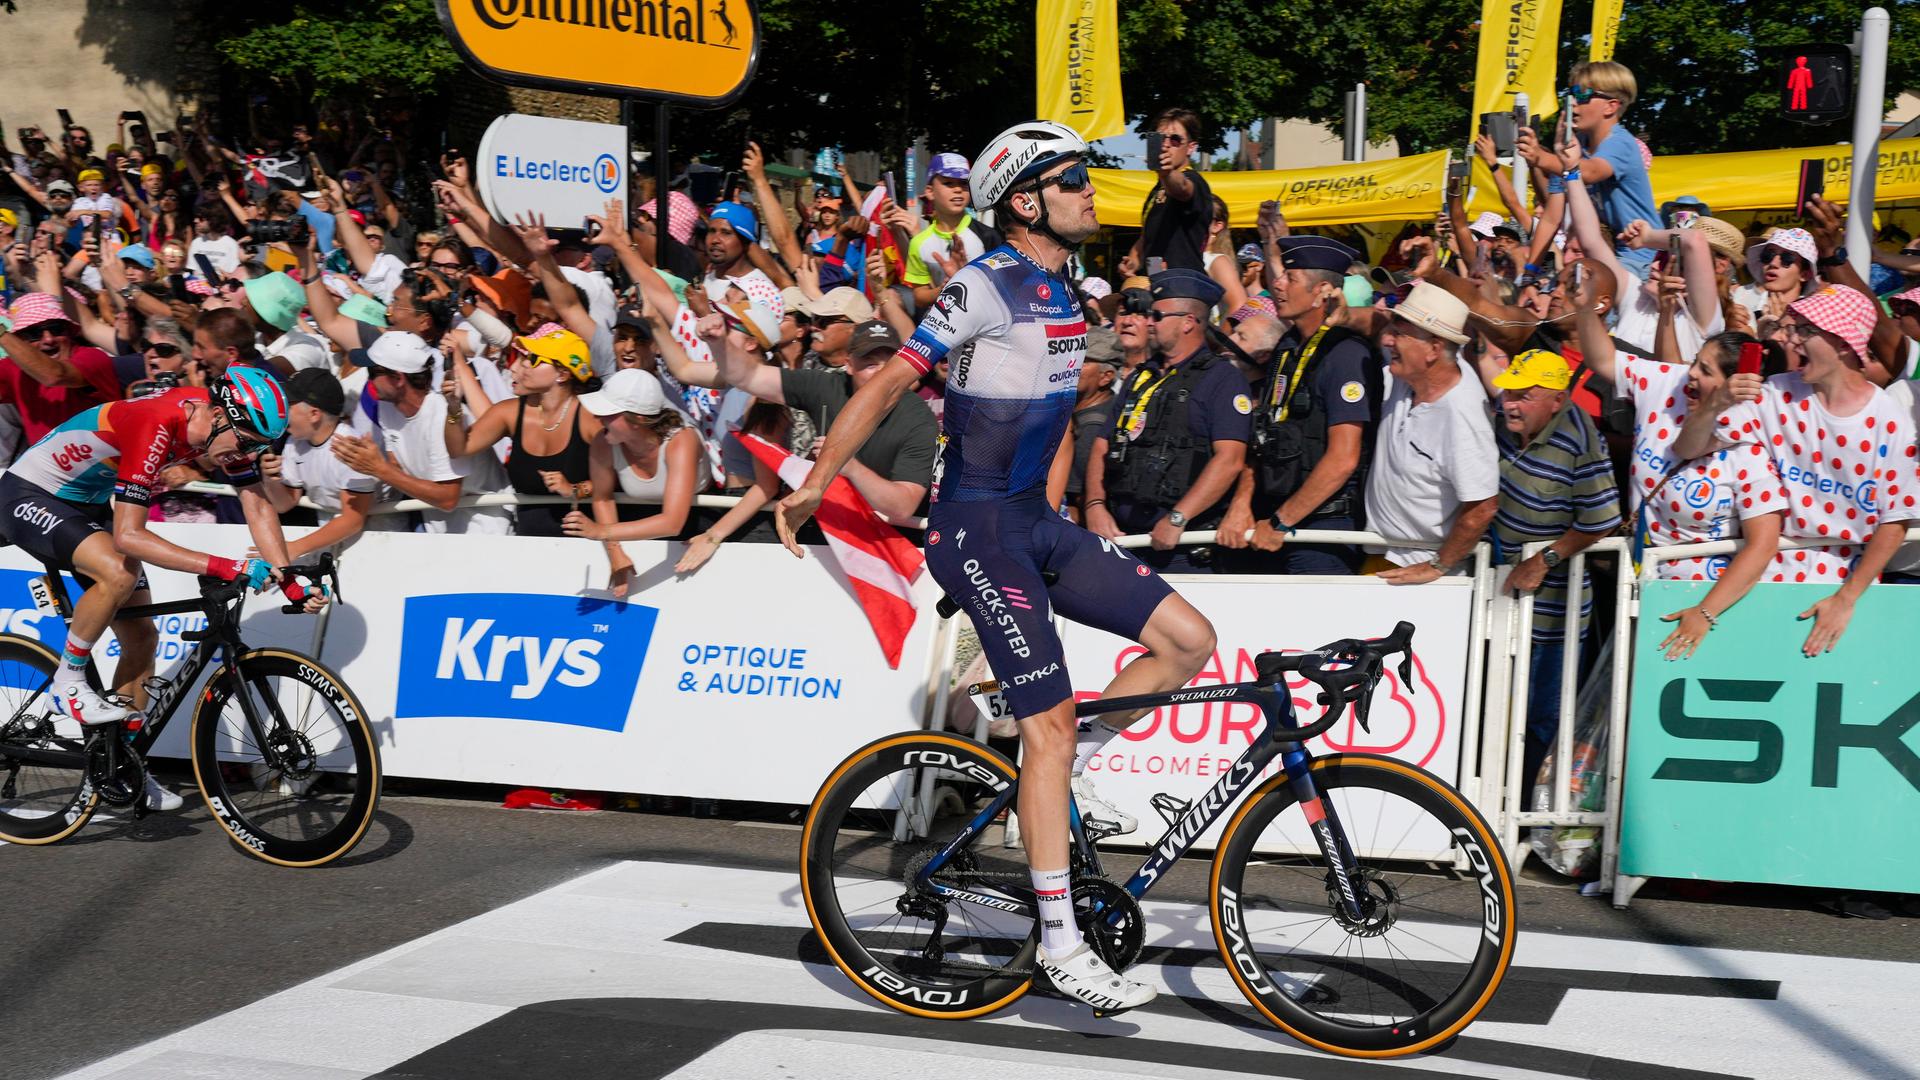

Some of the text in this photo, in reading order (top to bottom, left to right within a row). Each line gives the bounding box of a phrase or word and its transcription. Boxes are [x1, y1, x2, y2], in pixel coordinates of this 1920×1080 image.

[1068, 18, 1082, 106] OFFICIAL
[496, 154, 591, 184] E.Leclerc
[986, 142, 1039, 203] SPECIALIZED
[991, 152, 1012, 173] SOUDAL
[1827, 149, 1920, 173] OFCIAL
[1290, 174, 1379, 194] OFFICIAL
[1327, 188, 1377, 205] TEAM
[1381, 183, 1433, 200] SHOP
[1029, 303, 1063, 315] Ekopak
[957, 342, 976, 389] SOUDAL
[52, 443, 93, 472] lotto
[13, 502, 64, 535] dstny
[970, 595, 995, 626] FLOORS
[435, 617, 609, 700] Krys TM
[683, 643, 808, 670] OPTIQUE
[297, 664, 338, 698] SWISS
[678, 671, 842, 700] & AUDITION
[1013, 662, 1060, 685] DYKA
[1169, 687, 1238, 703] SPECIALIZED
[903, 750, 1012, 792] roval
[208, 796, 267, 852] DT SWISS
[1139, 757, 1256, 888] S-WORKS
[1318, 823, 1356, 902] SPECIALIZED
[941, 887, 1020, 912] SPECIALIZED
[1452, 826, 1501, 948] roval
[1222, 886, 1276, 995] roval
[863, 966, 969, 1007] roval
